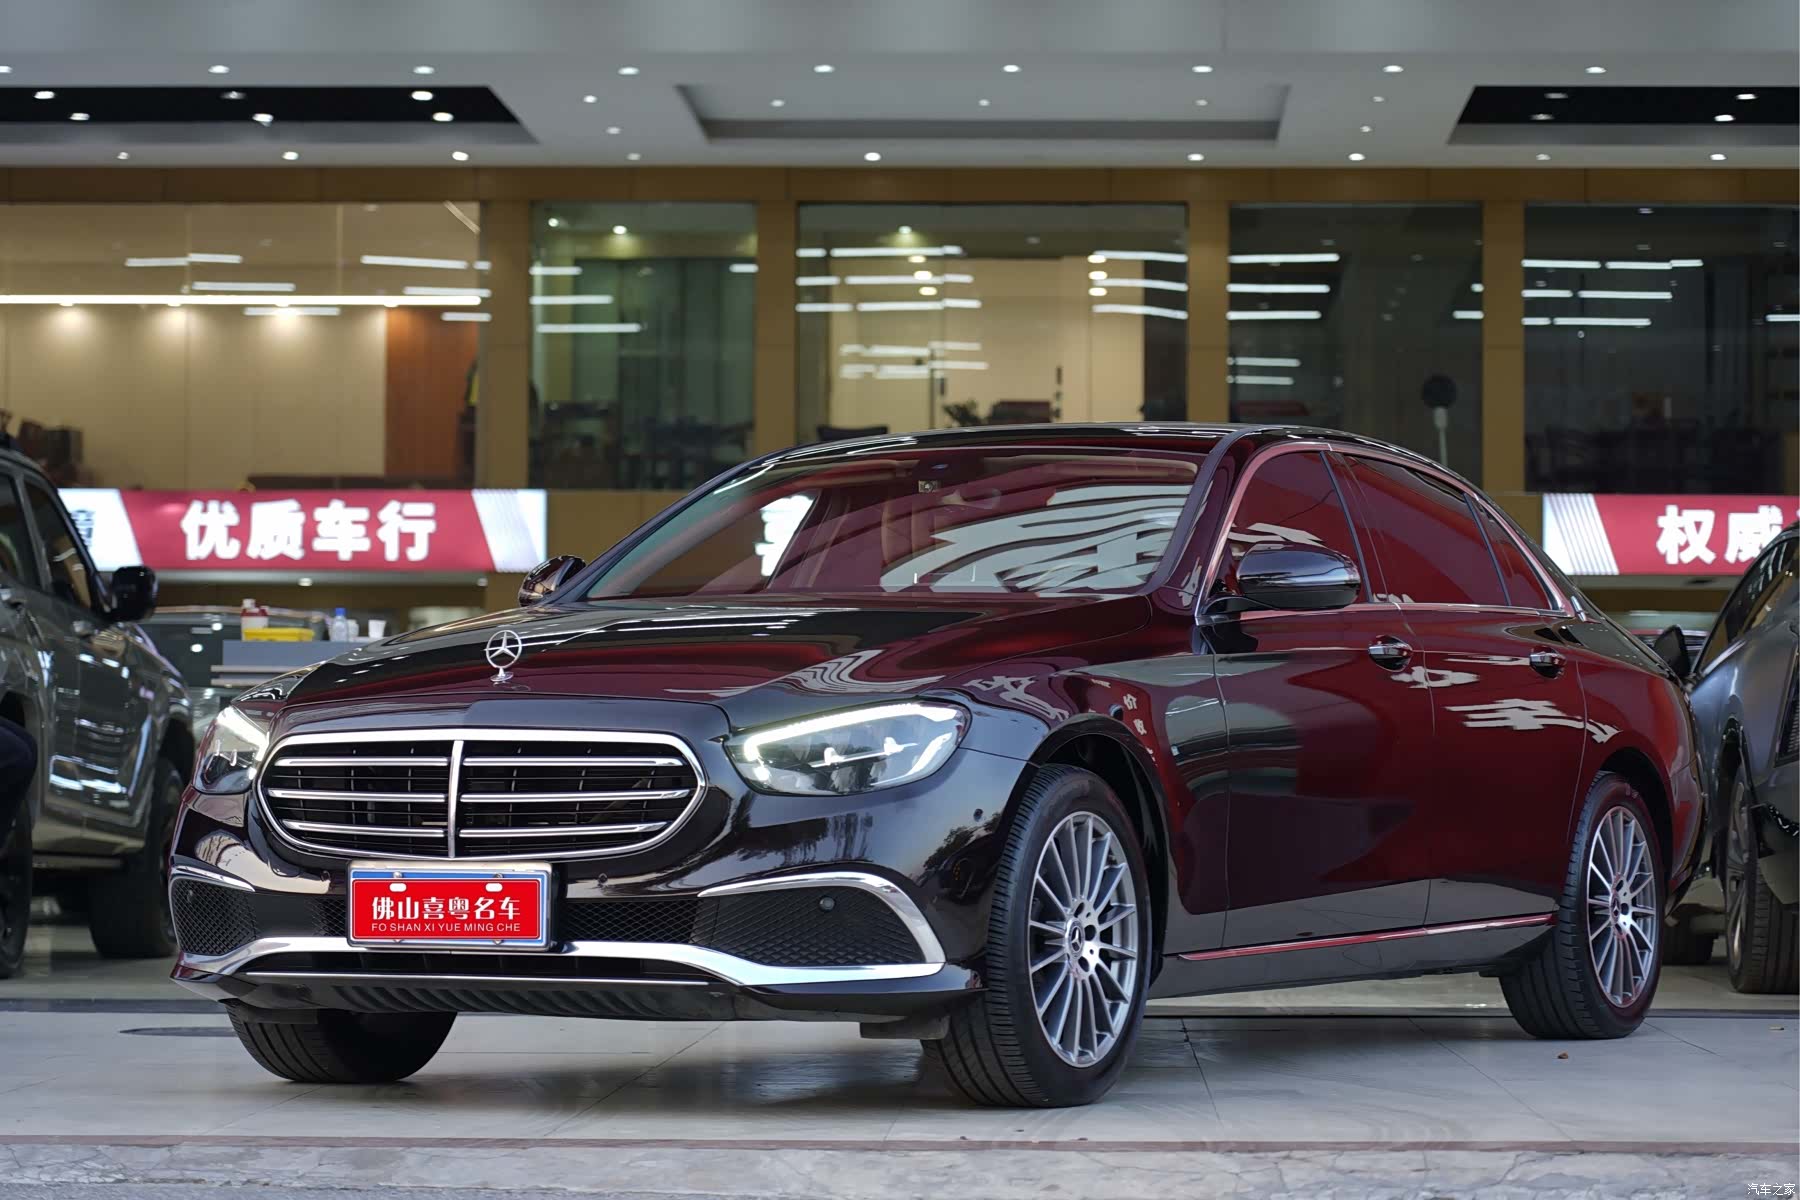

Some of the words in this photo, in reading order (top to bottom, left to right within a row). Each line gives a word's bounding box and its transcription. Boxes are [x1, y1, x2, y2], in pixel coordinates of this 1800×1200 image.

[181, 499, 437, 562] 优质车行
[1656, 504, 1800, 565] 权威
[371, 896, 521, 920] 佛山喜粤名车
[371, 922, 387, 932] FO
[389, 922, 421, 932] SHAN
[424, 922, 435, 932] XI
[438, 922, 461, 932] YUE
[464, 922, 494, 932] MING
[496, 922, 521, 932] CHE
